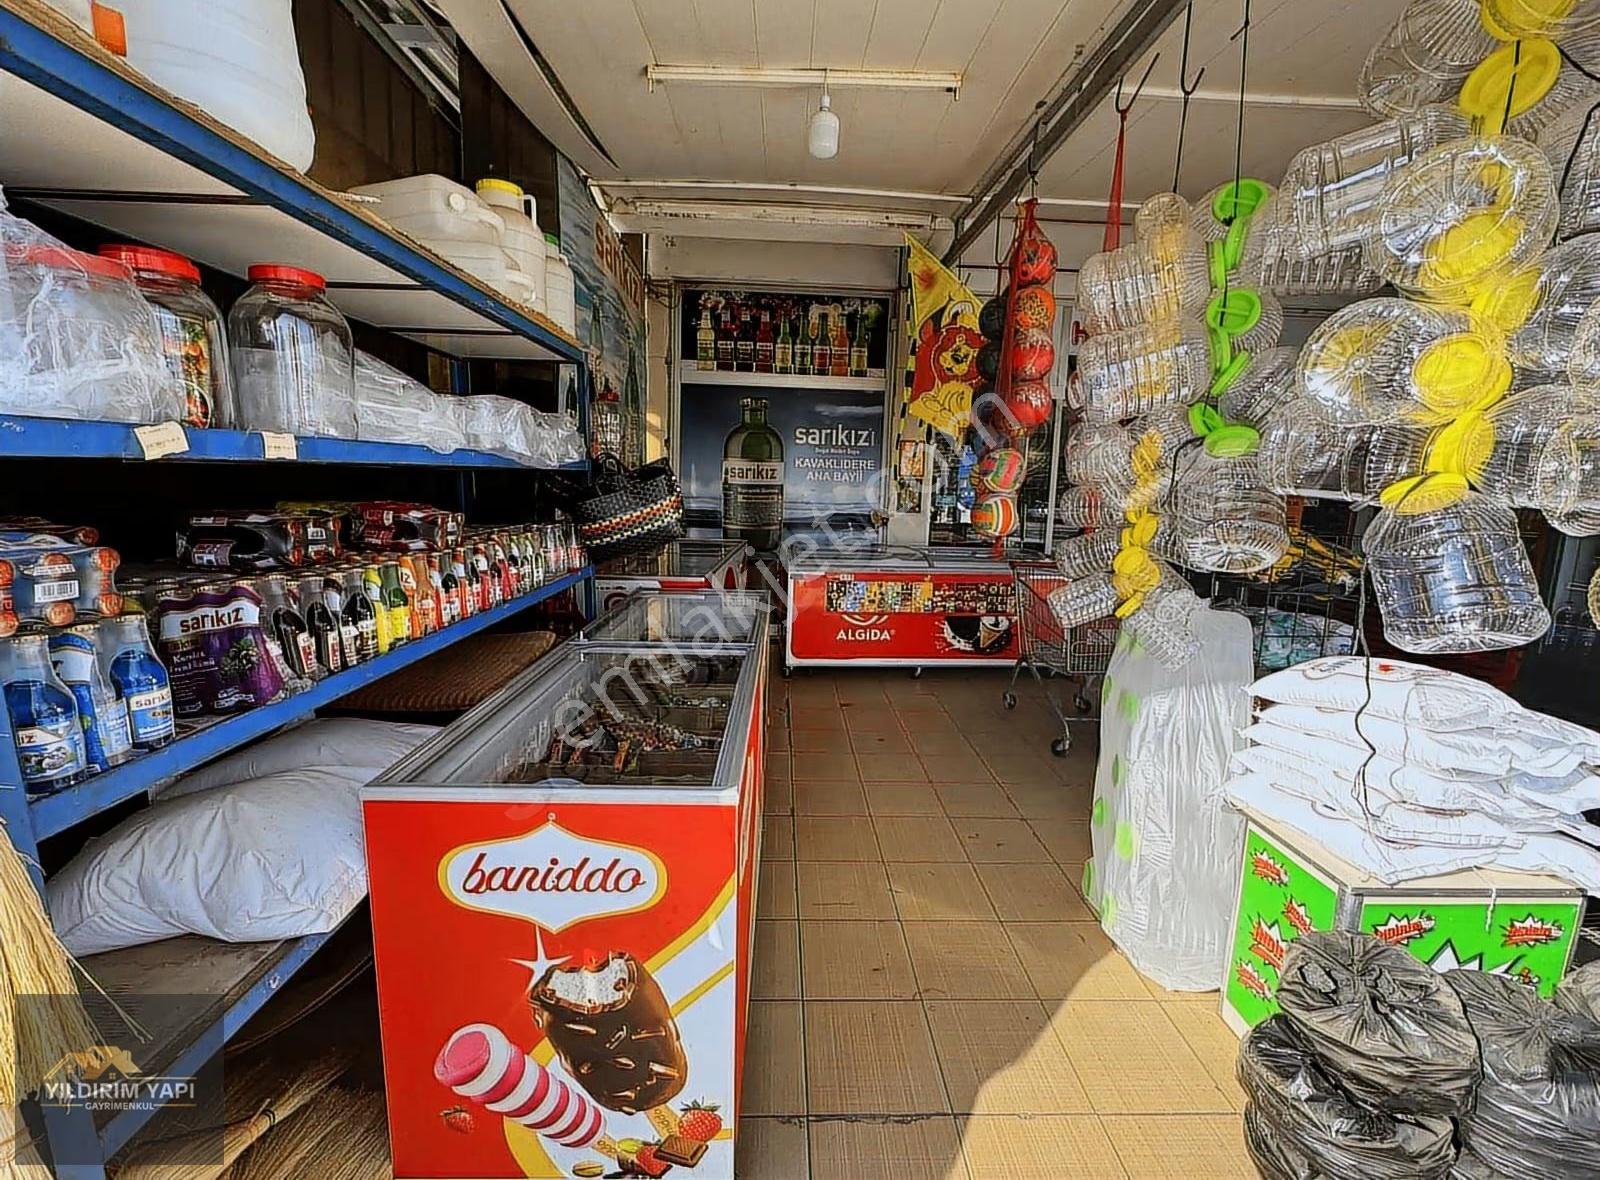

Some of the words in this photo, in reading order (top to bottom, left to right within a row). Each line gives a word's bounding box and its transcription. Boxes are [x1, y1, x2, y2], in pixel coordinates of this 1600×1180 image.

[729, 463, 778, 480] sarıkız
[179, 607, 245, 634] sarıkız
[462, 853, 648, 894] baniddo
